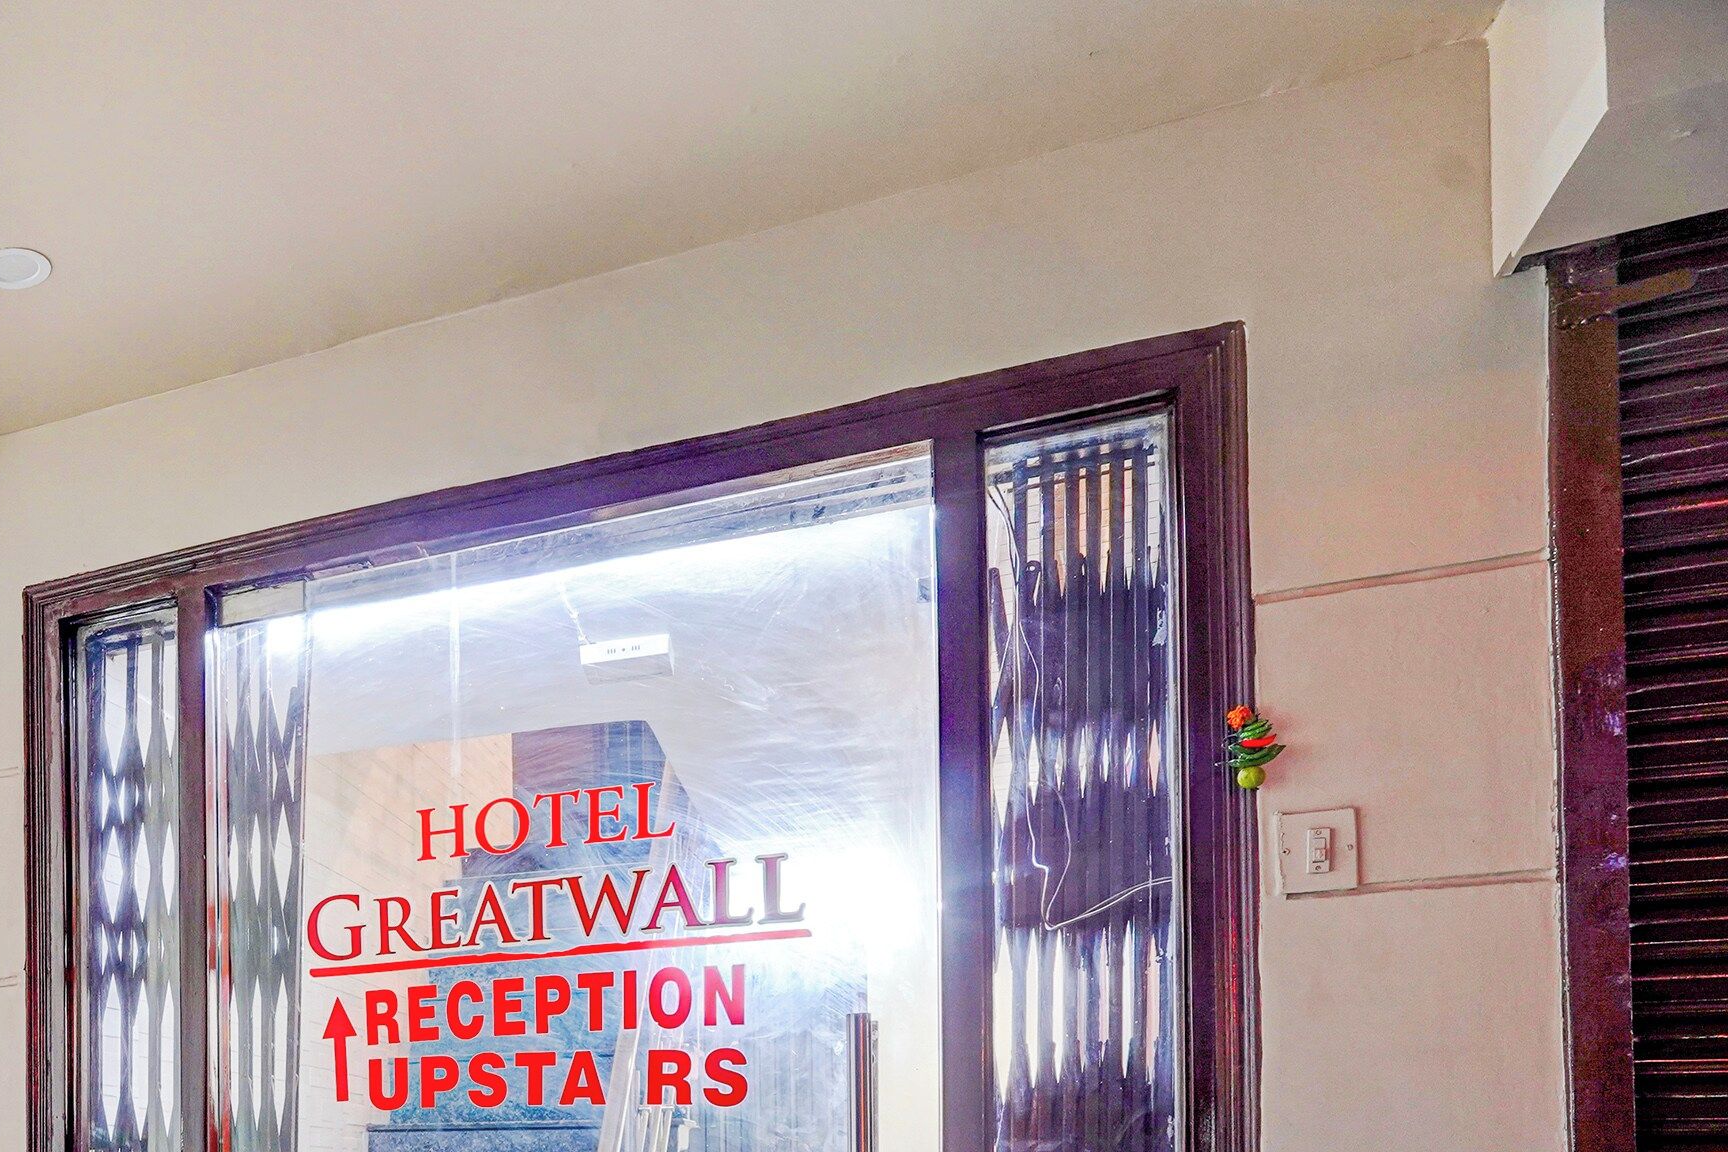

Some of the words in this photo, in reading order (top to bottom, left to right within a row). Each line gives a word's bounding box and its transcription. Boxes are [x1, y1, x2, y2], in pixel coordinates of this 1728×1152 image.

[416, 781, 676, 861] HOTEL
[307, 852, 807, 961] GREATWALL
[365, 964, 746, 1046] RECEPTION
